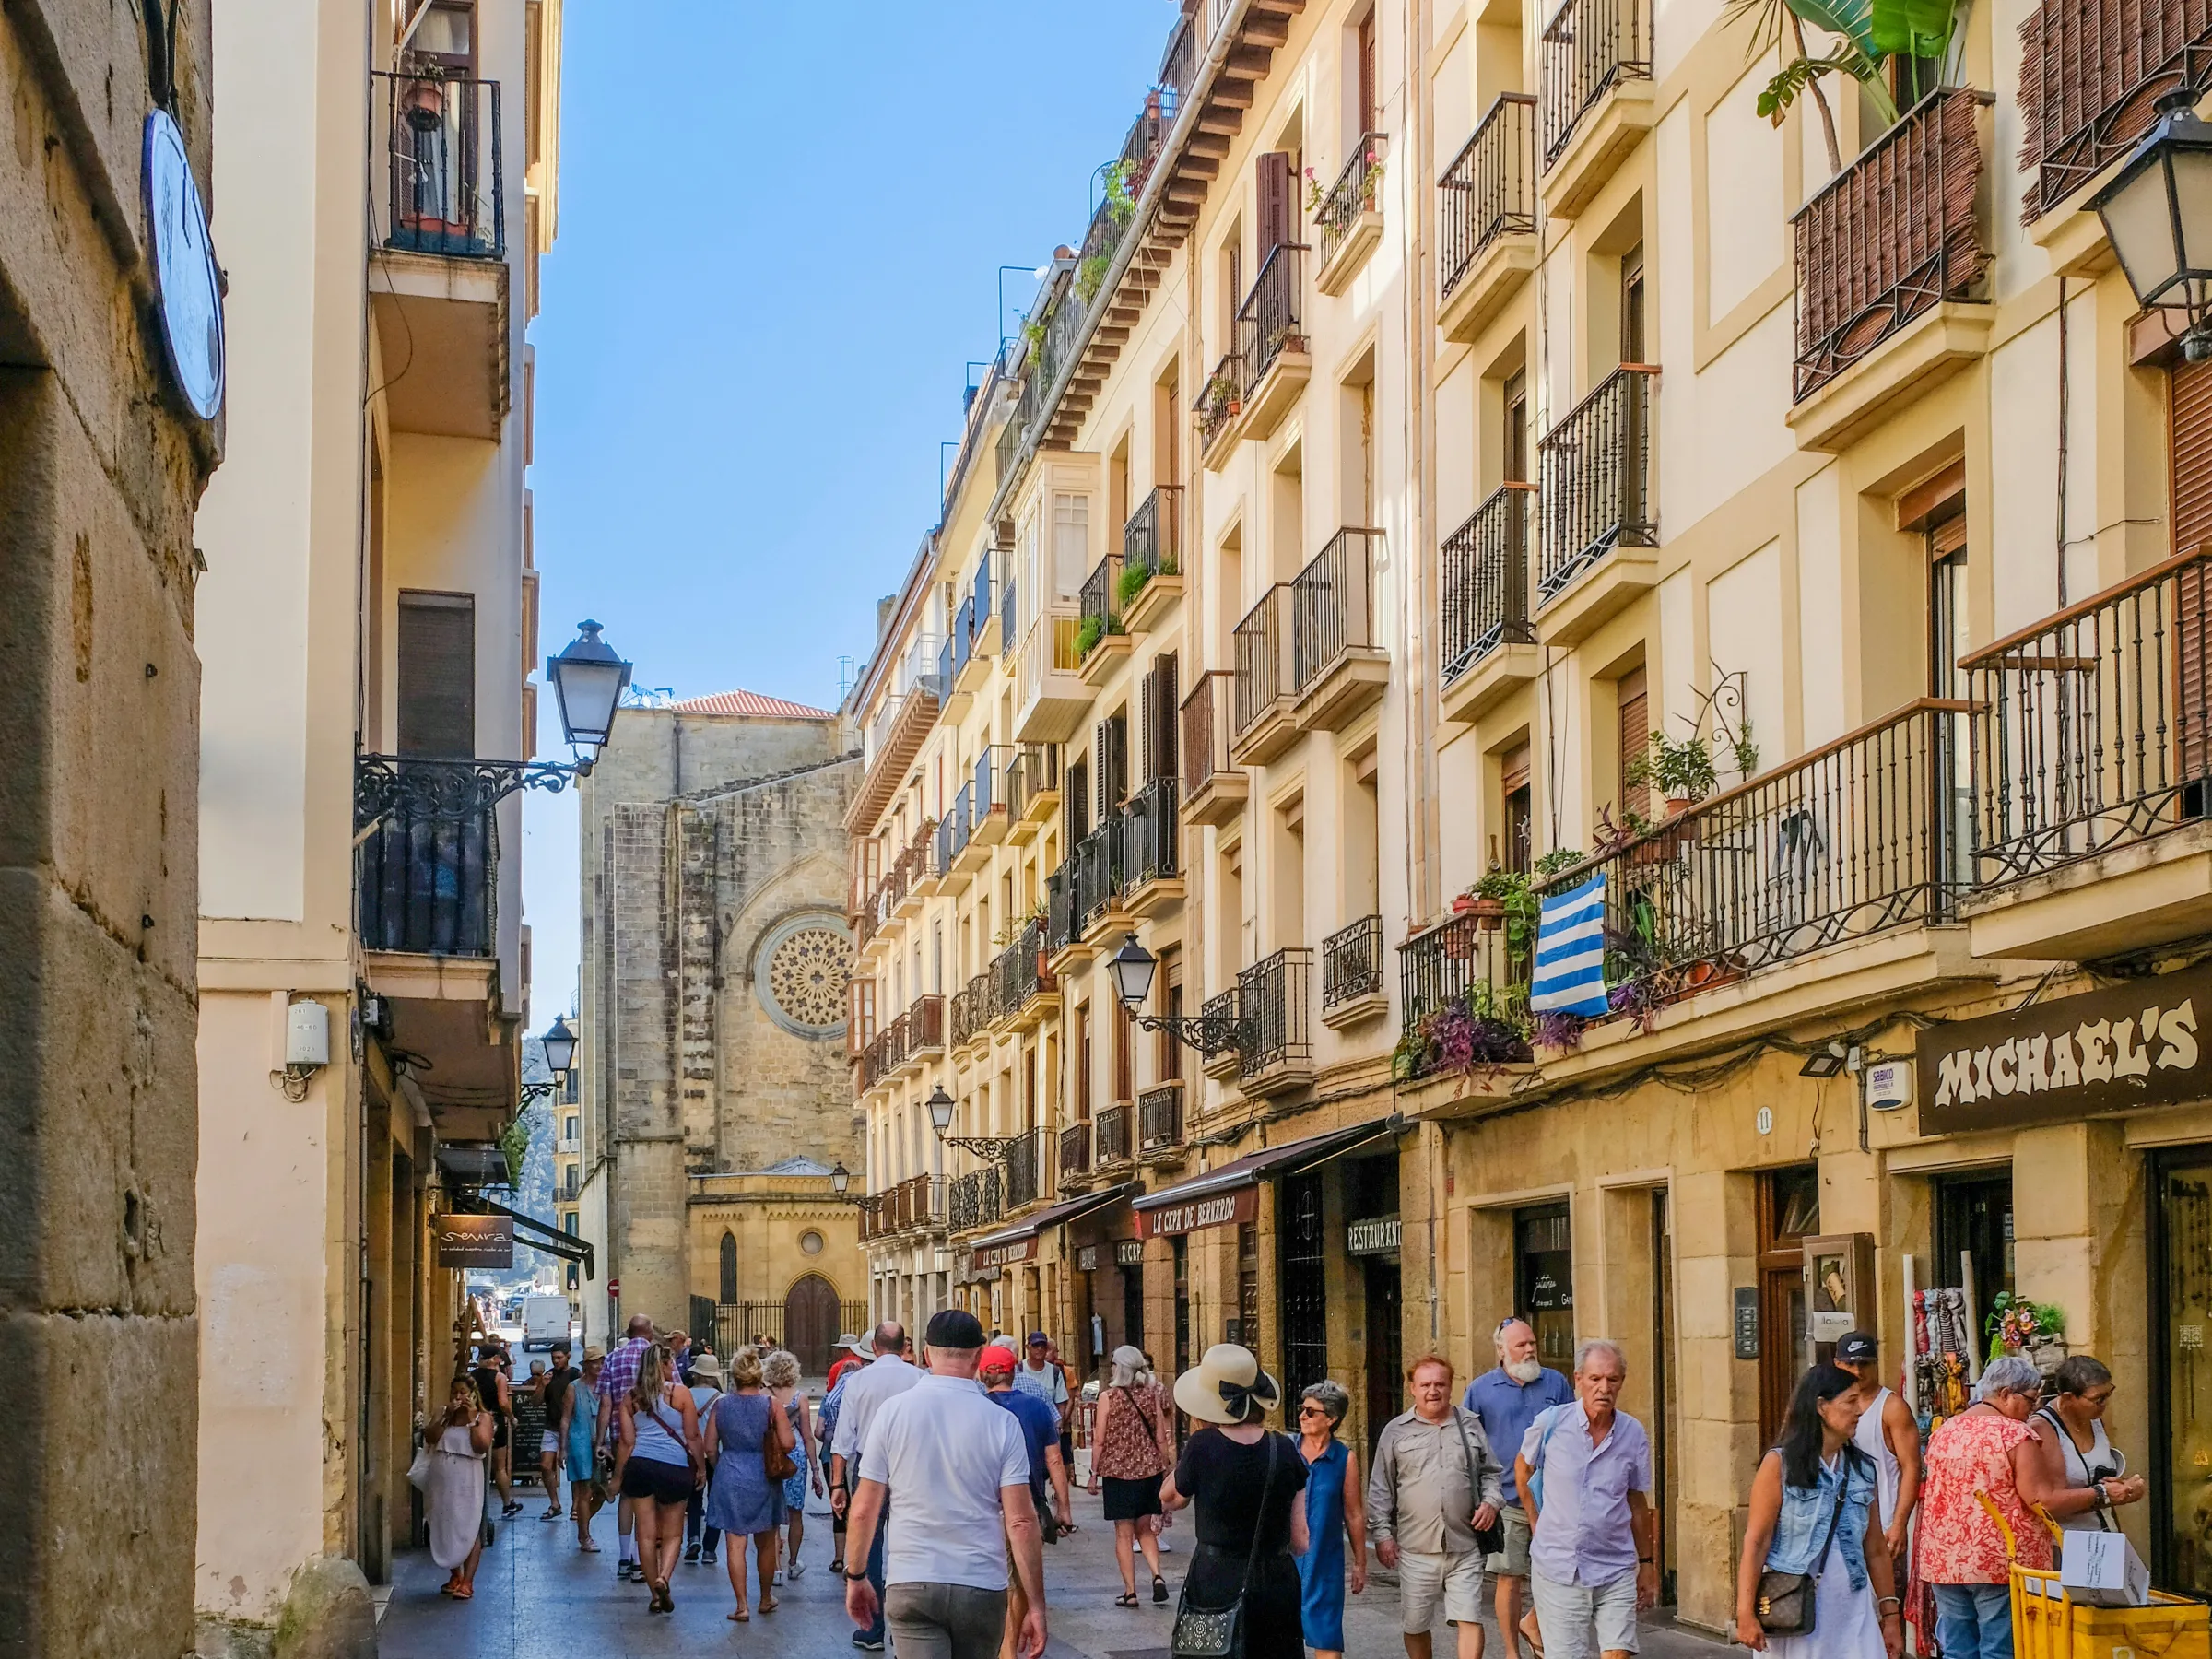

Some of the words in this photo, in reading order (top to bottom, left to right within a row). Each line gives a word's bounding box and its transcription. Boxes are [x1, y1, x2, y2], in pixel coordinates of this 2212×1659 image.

[1936, 998, 2199, 1108] MICHAEL'S
[1153, 1212, 1162, 1234] LA
[1164, 1208, 1182, 1232] CEPA
[1184, 1206, 1195, 1230] DE
[1197, 1196, 1236, 1227] BERNARDO
[1127, 1242, 1143, 1262] CEP
[1347, 1220, 1401, 1251] RESTAURANT
